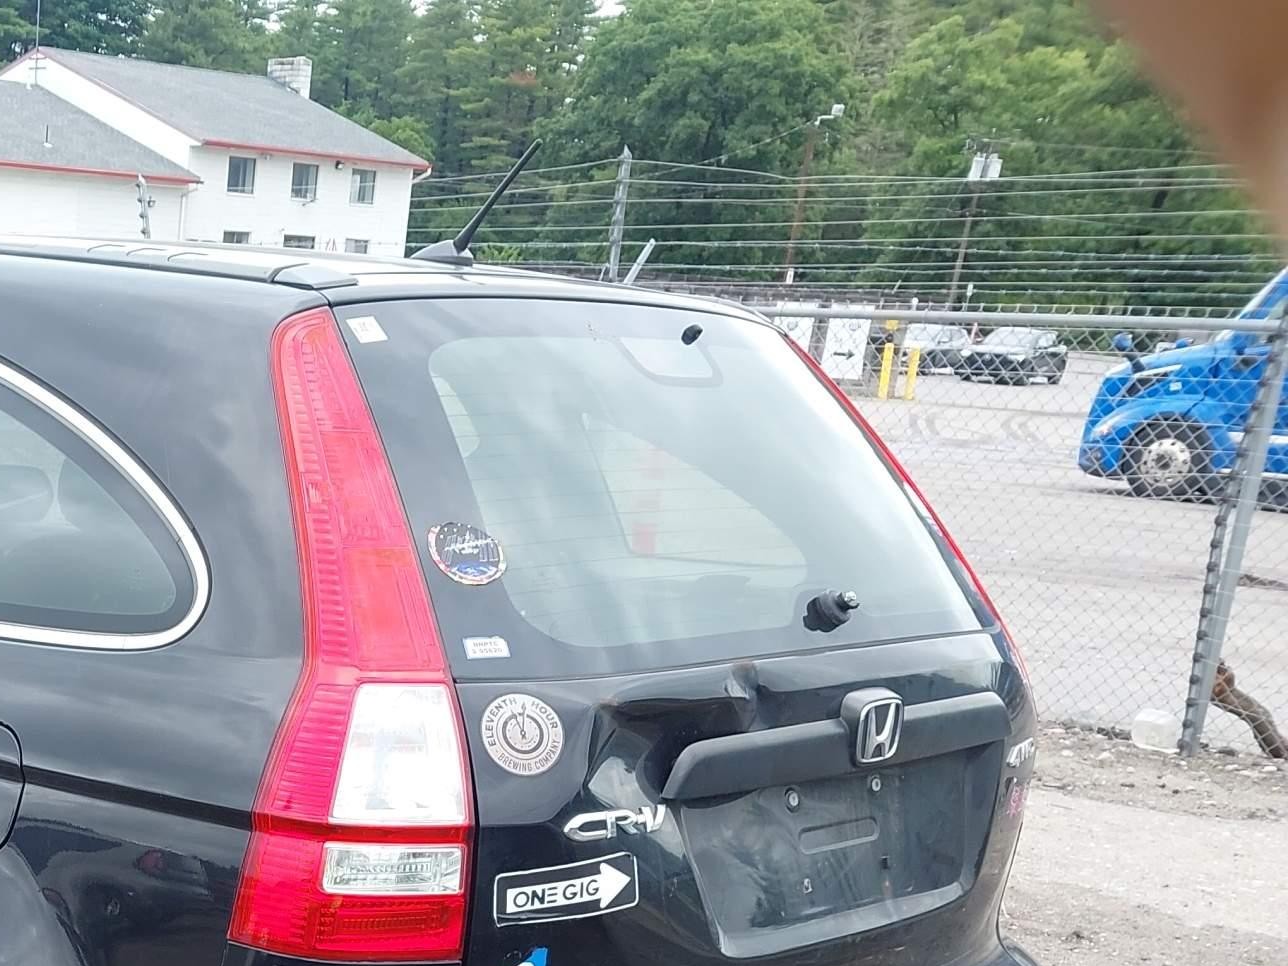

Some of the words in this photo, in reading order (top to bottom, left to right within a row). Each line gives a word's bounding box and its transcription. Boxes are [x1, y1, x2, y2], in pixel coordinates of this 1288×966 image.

[485, 697, 518, 747] ELEVENTH
[530, 700, 559, 730] HOUR
[497, 752, 533, 773] BREWING
[534, 739, 561, 771] COMPANY
[563, 804, 667, 842] CR-V
[513, 887, 558, 908] ONE
[562, 879, 600, 901] GIG
